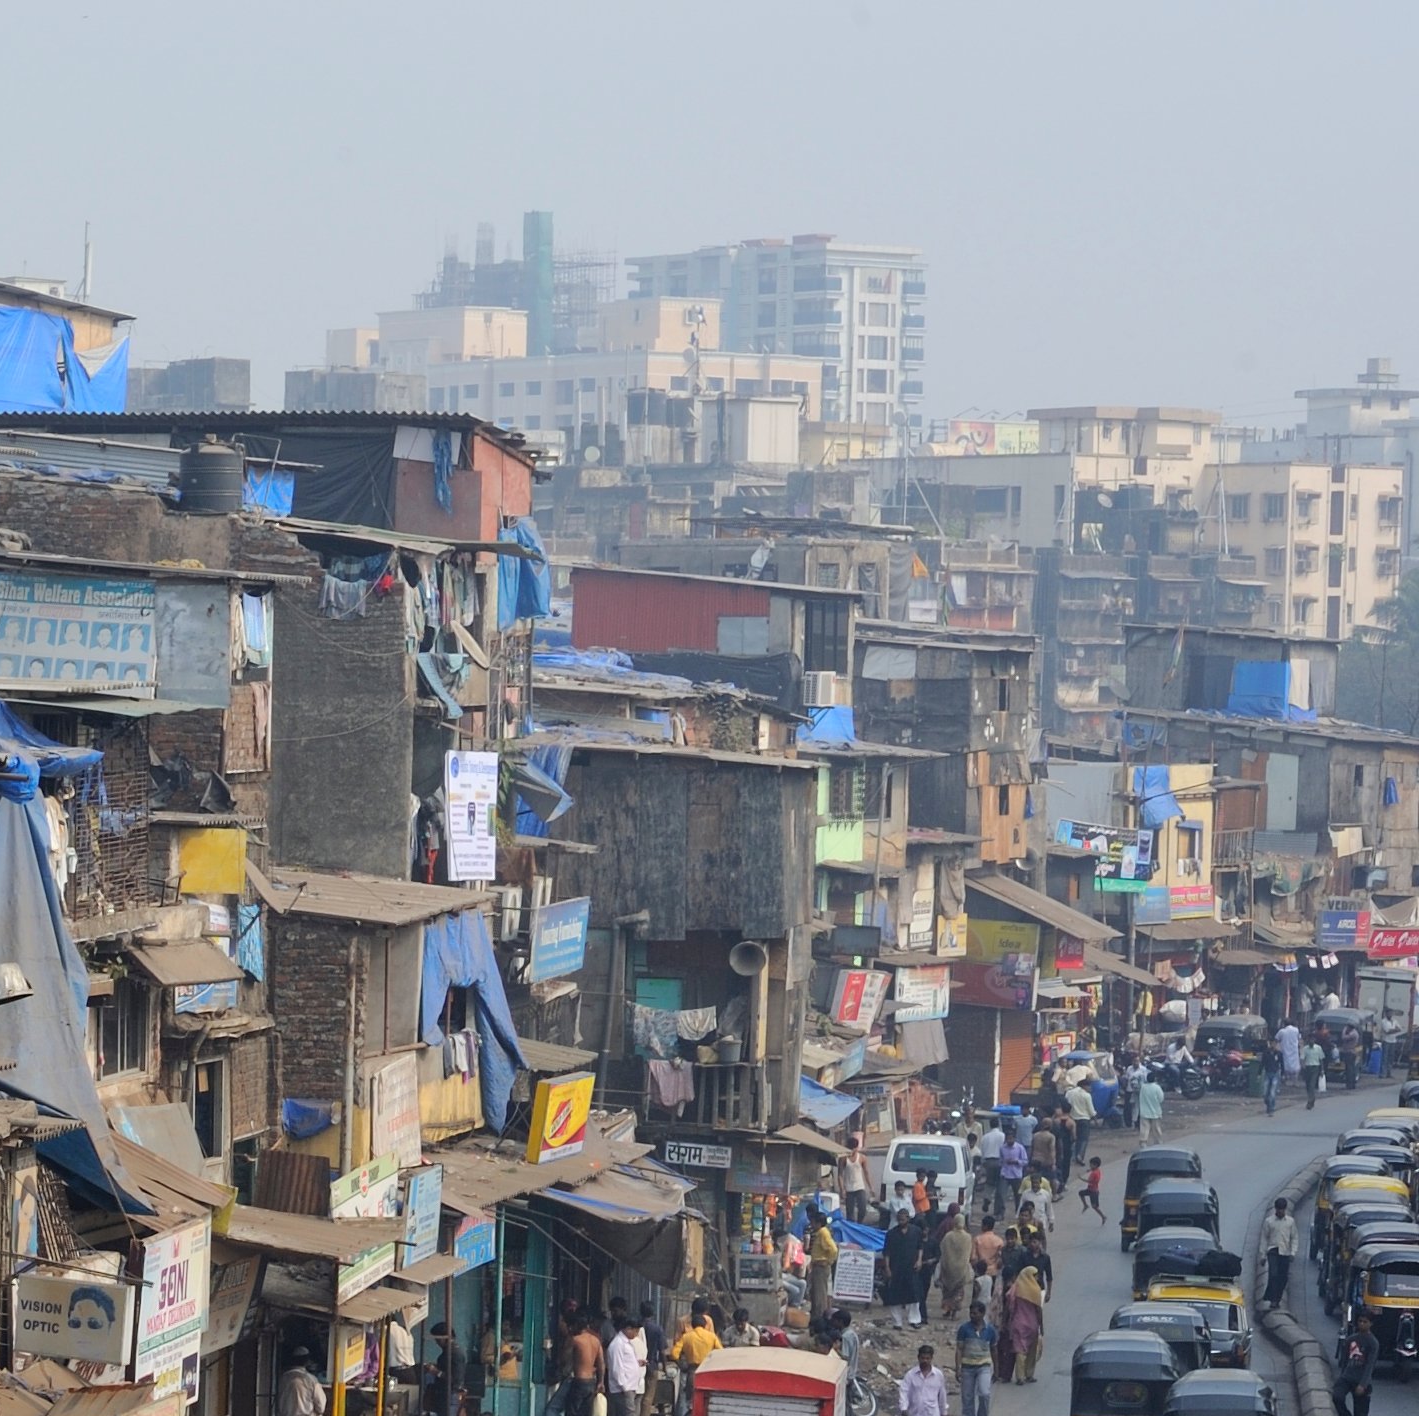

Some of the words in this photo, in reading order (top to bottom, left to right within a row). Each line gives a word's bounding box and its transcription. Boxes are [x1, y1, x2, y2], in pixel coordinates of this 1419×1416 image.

[34, 582, 81, 605] Welfare
[158, 1258, 190, 1311] SONI
[21, 1300, 62, 1315] VISION
[23, 1319, 60, 1334] OPTIC
